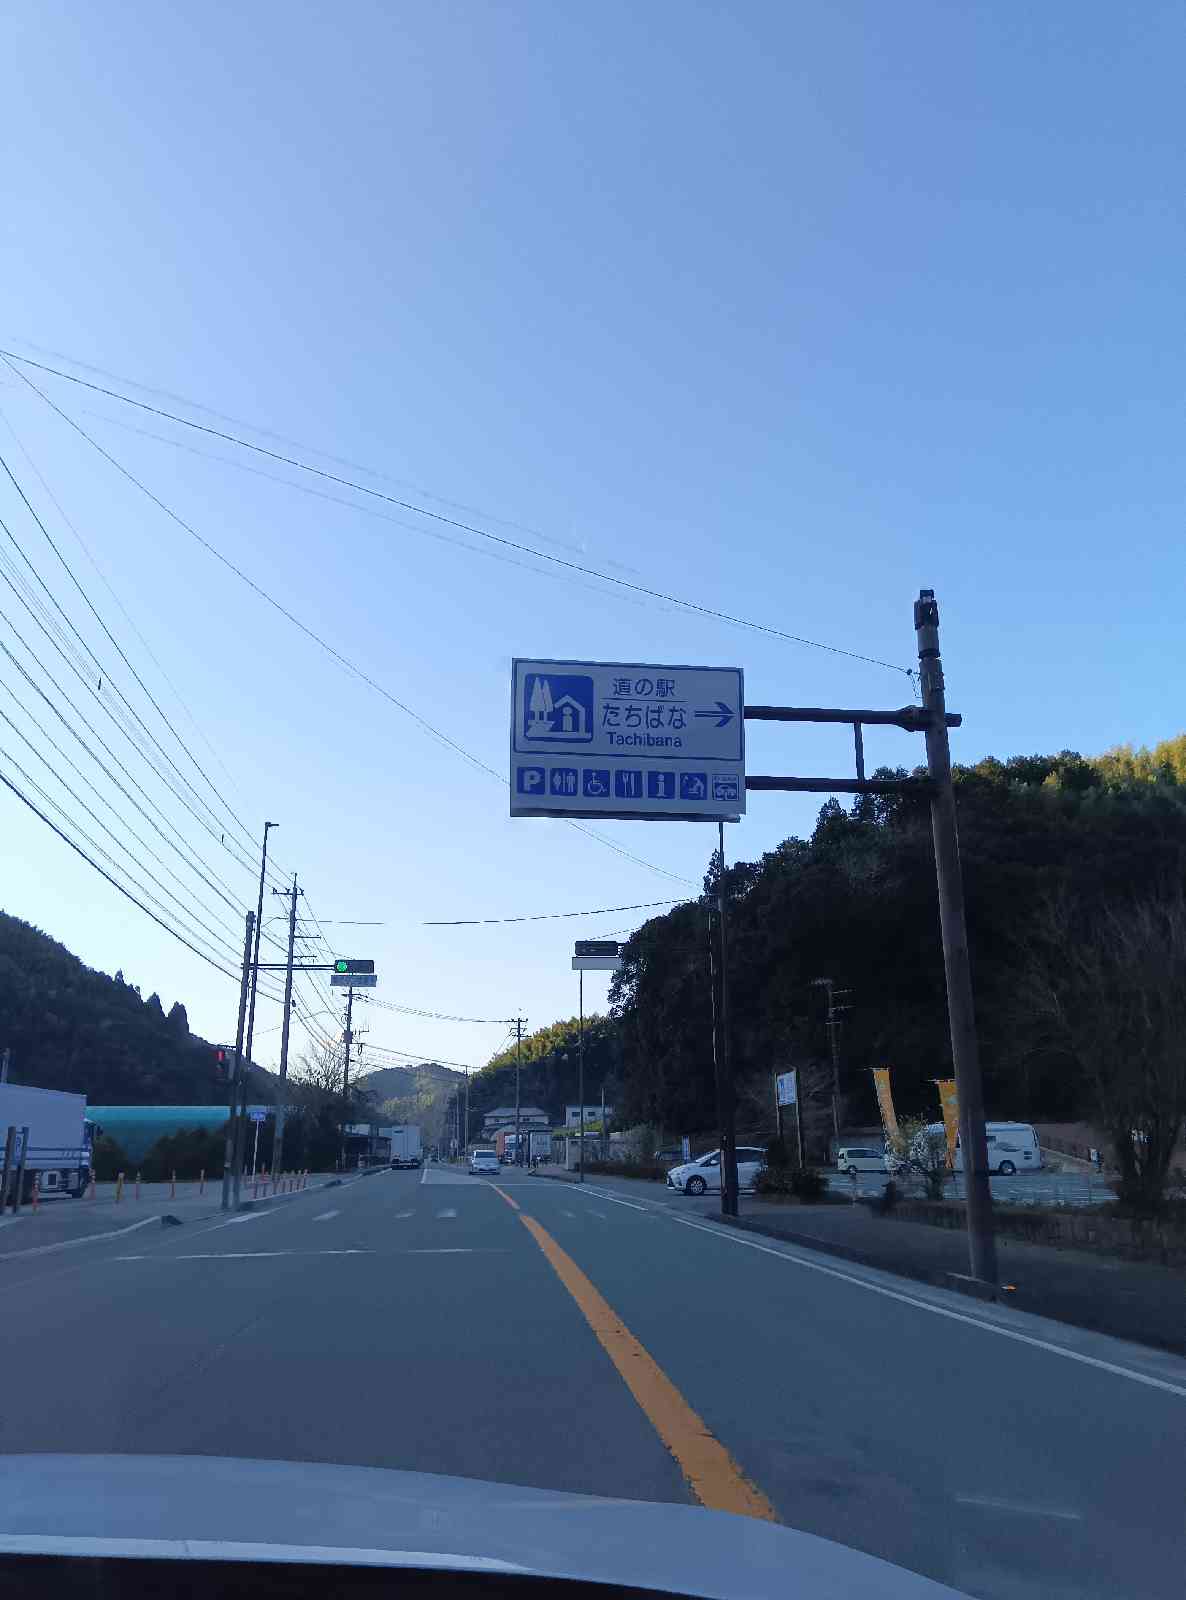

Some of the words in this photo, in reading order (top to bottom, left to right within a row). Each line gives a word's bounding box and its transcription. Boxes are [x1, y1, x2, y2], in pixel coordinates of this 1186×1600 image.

[612, 678, 676, 698] 道の駅
[601, 703, 687, 729] たちばな
[606, 731, 682, 748] Tachibana
